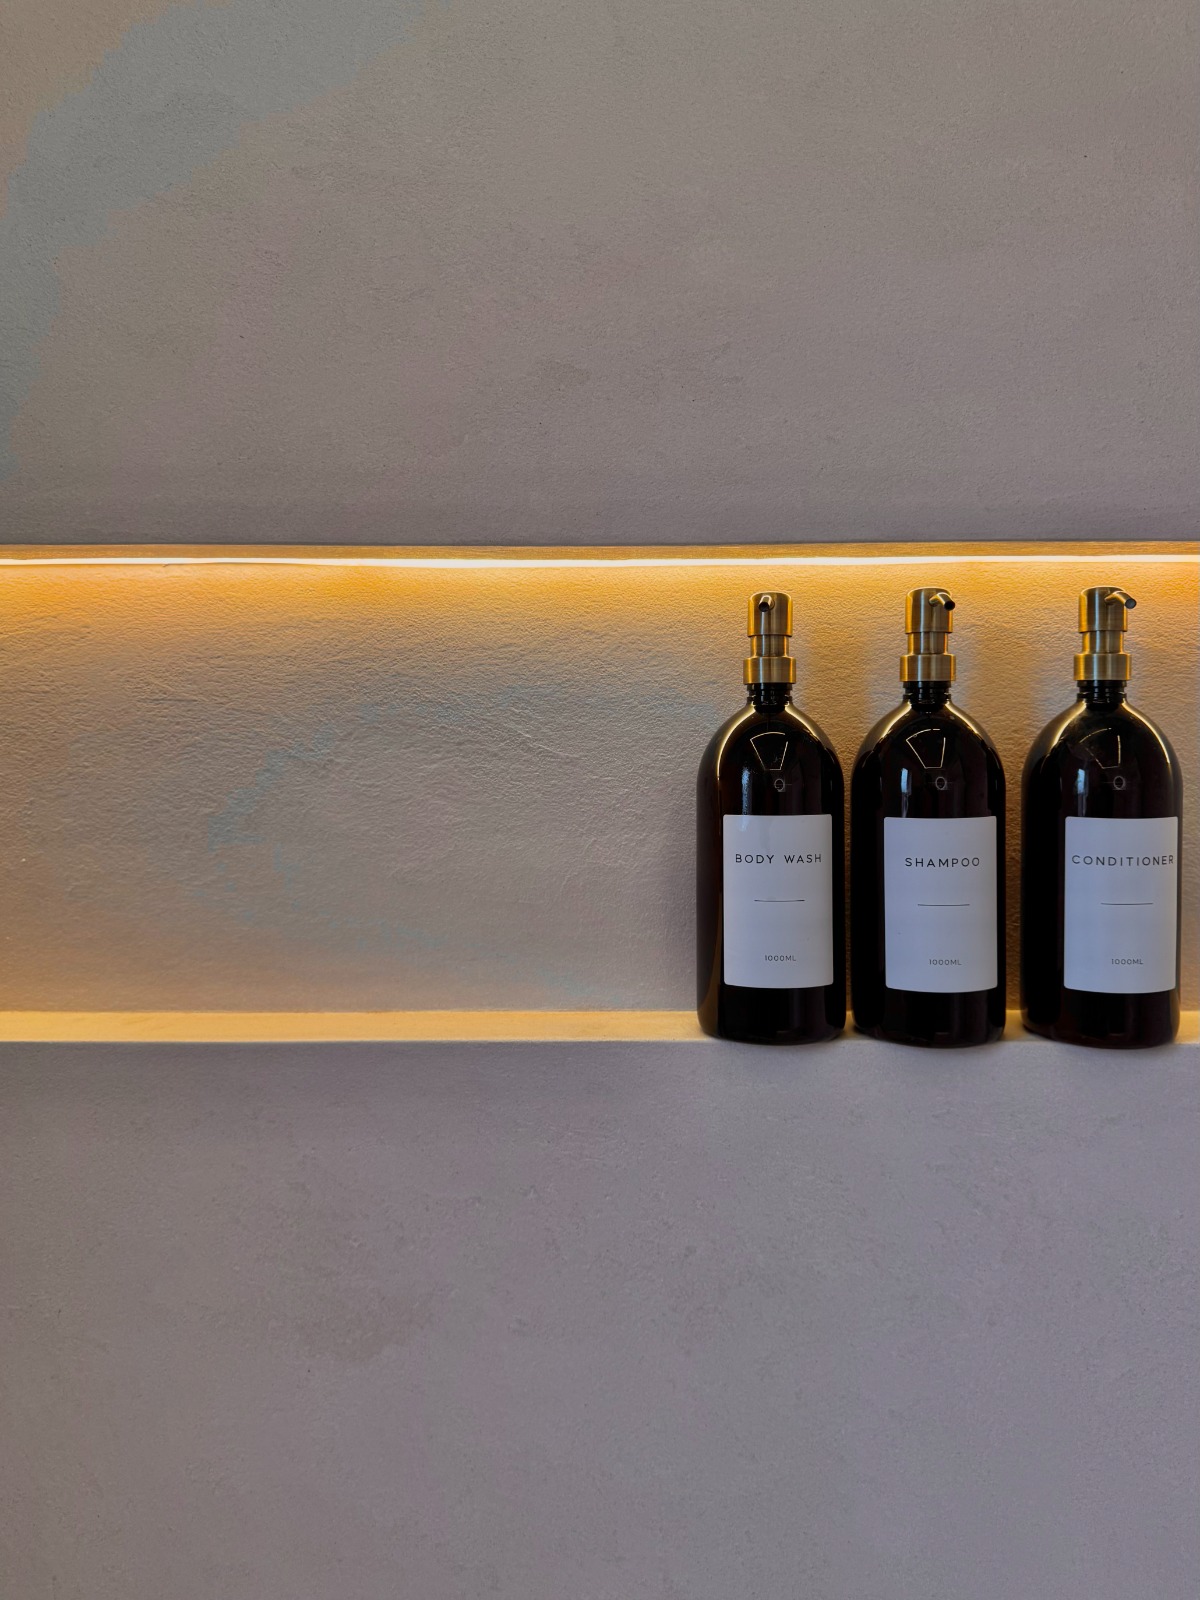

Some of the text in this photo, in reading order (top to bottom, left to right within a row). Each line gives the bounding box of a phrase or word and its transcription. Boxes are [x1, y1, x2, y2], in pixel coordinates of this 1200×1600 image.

[735, 853, 822, 865] BODY WASH
[904, 857, 980, 868] SHAMPOO
[1071, 854, 1174, 867] CONDITIONER
